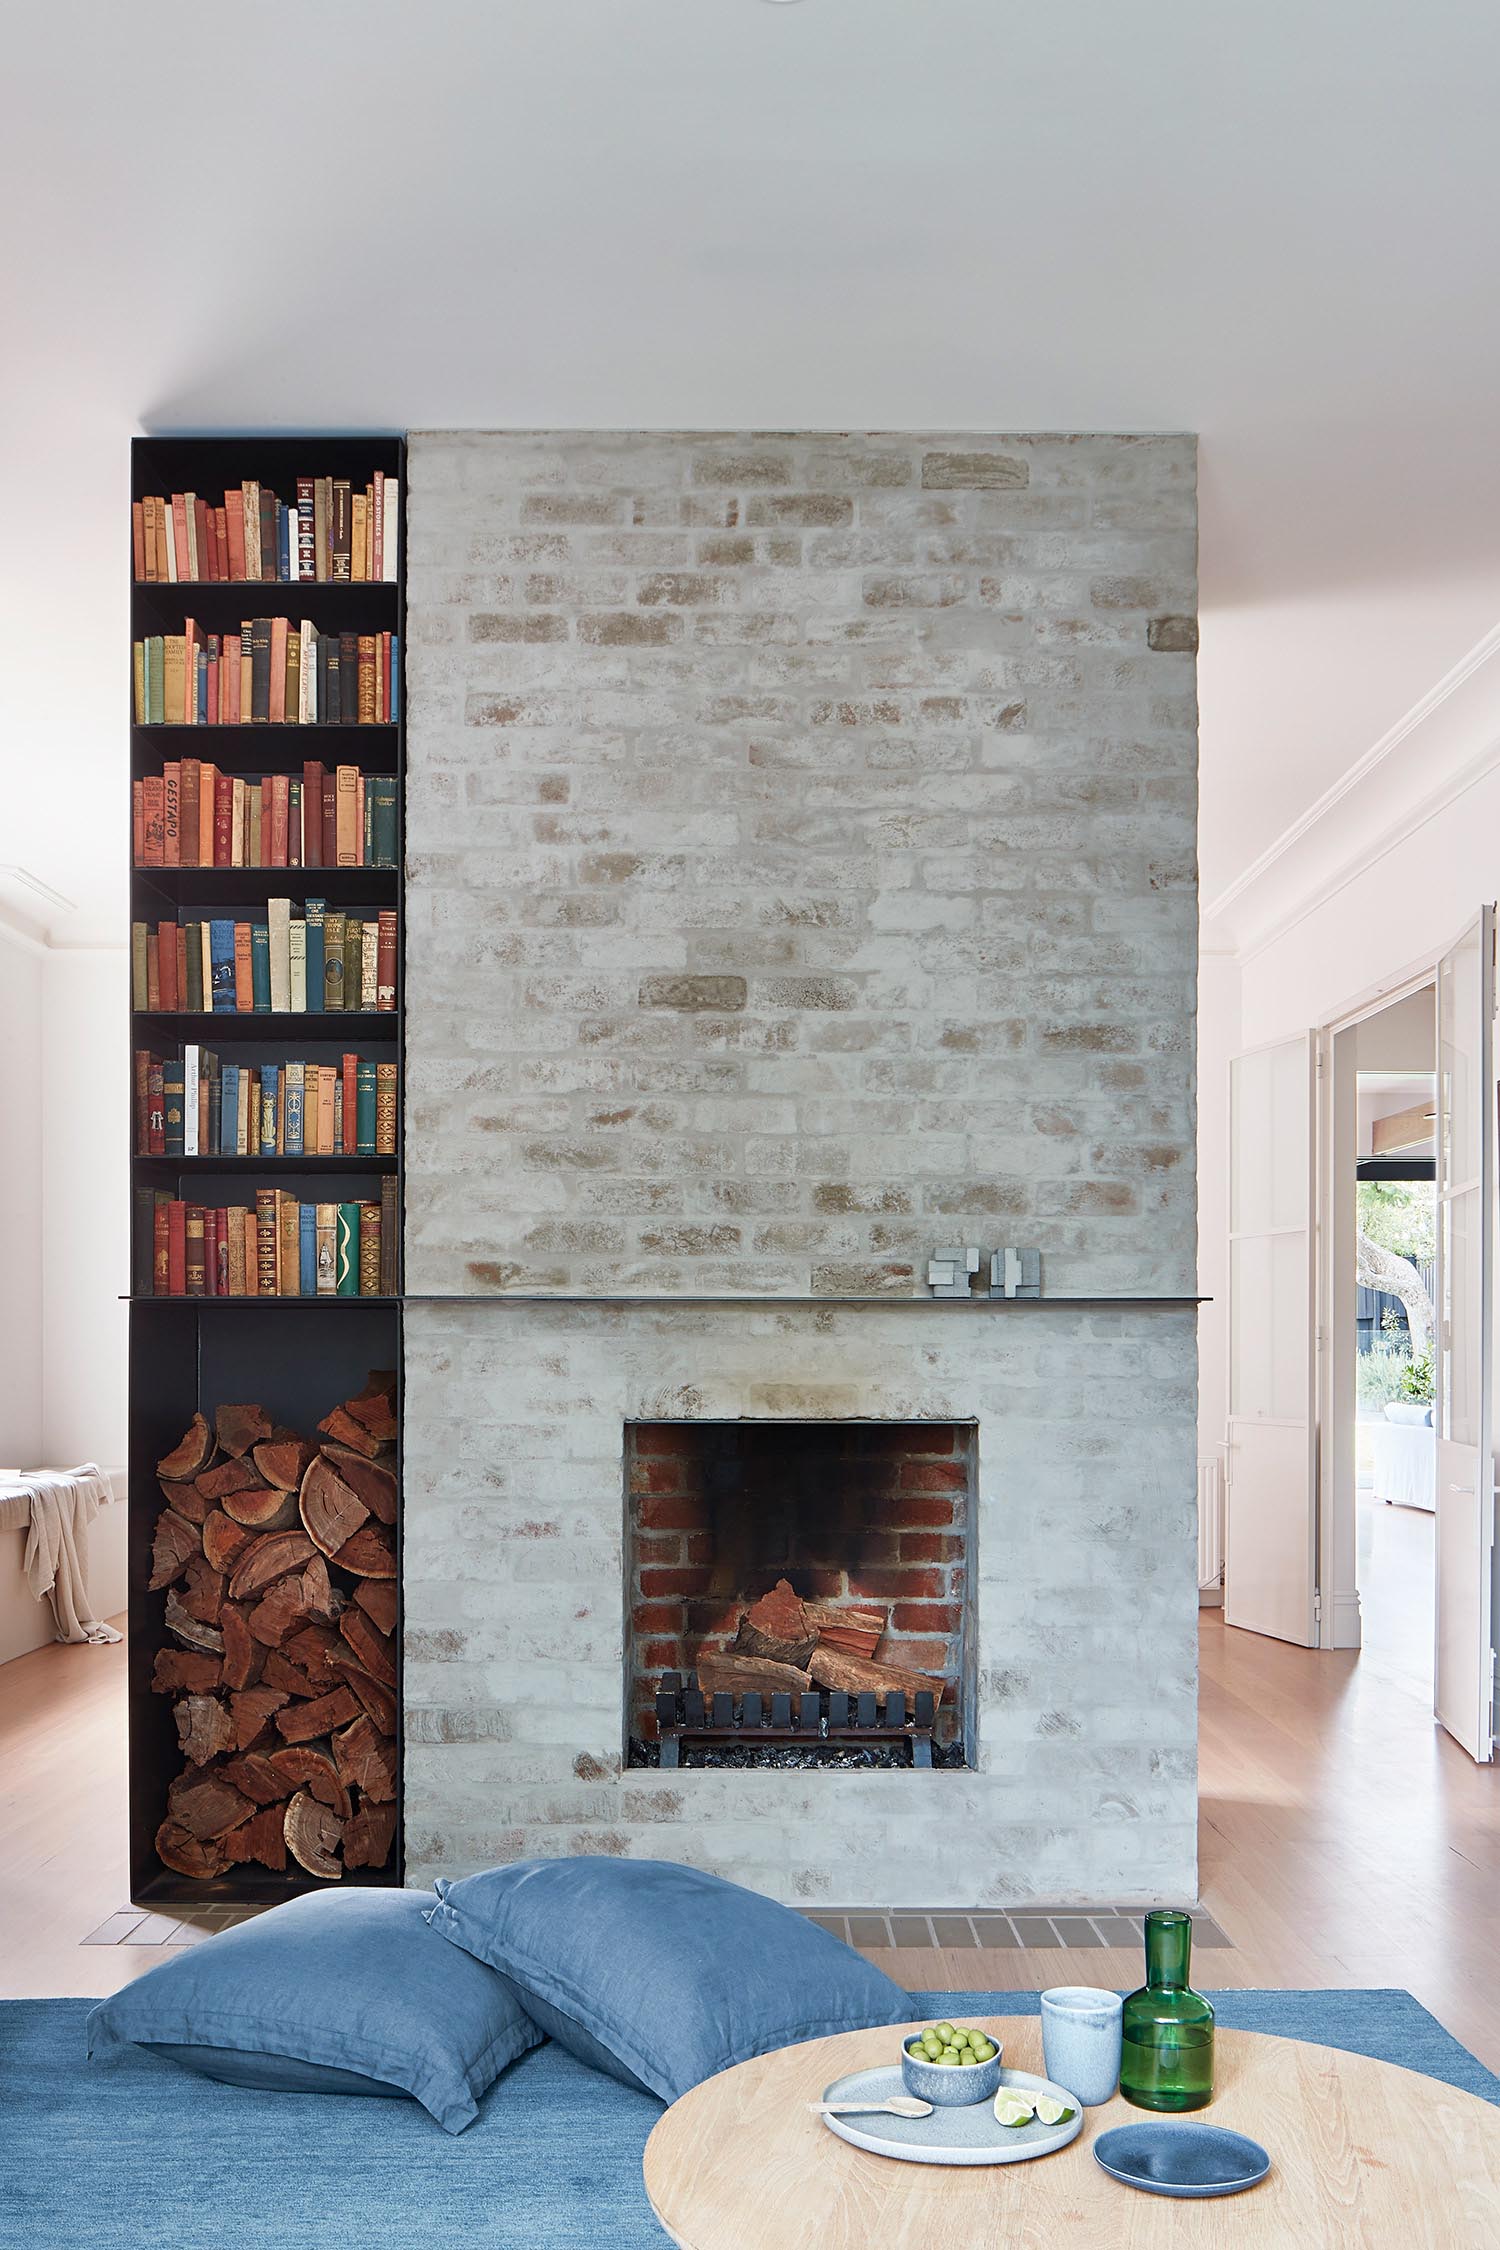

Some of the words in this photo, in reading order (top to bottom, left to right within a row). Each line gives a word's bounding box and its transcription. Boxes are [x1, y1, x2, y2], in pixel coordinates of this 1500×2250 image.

[375, 496, 382, 506] SO
[167, 779, 178, 837] GESTAPO
[189, 1089, 197, 1110] Phillip
